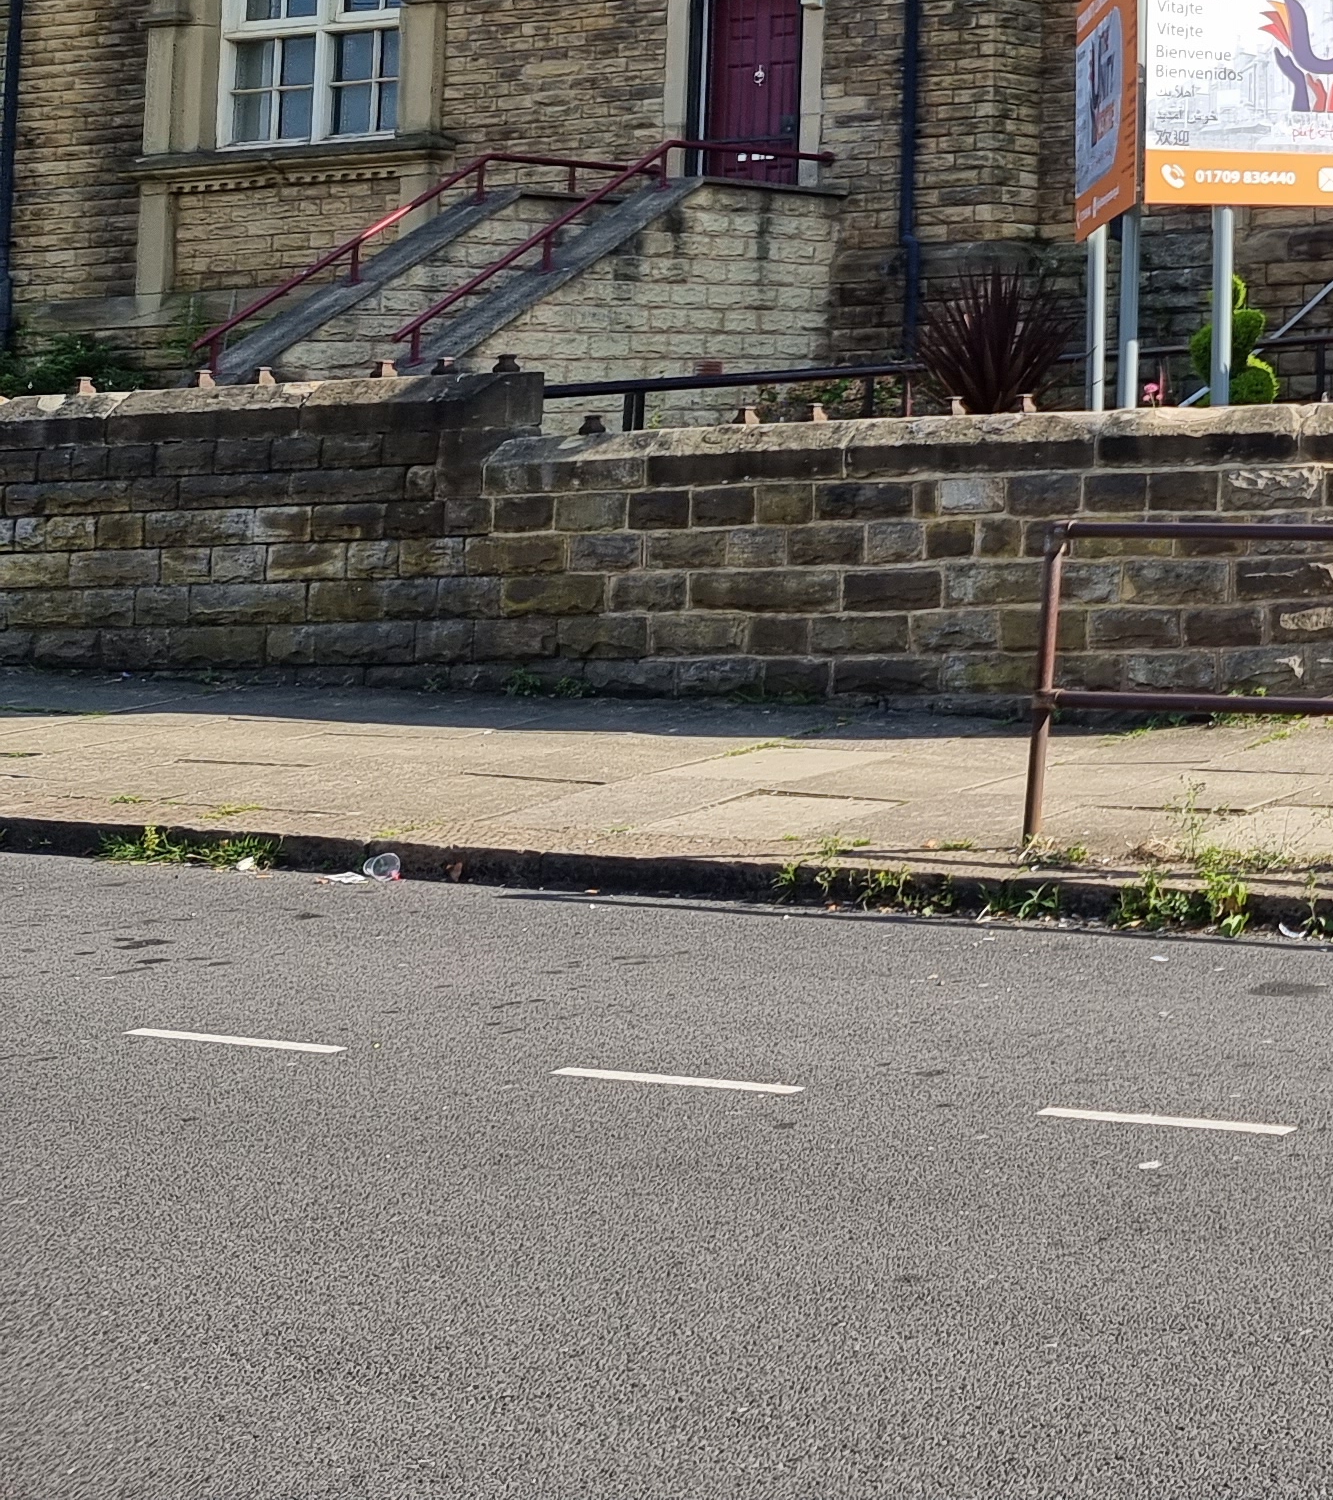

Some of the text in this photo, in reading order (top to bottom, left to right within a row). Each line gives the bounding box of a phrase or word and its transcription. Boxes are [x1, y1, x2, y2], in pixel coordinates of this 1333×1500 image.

[1157, 0, 1203, 17] Vitajte
[1156, 44, 1231, 61] Bienvenue
[1155, 64, 1243, 81] Bienvenidos
[1155, 128, 1189, 147] 欢迎
[1195, 169, 1296, 185] 01709 836440
